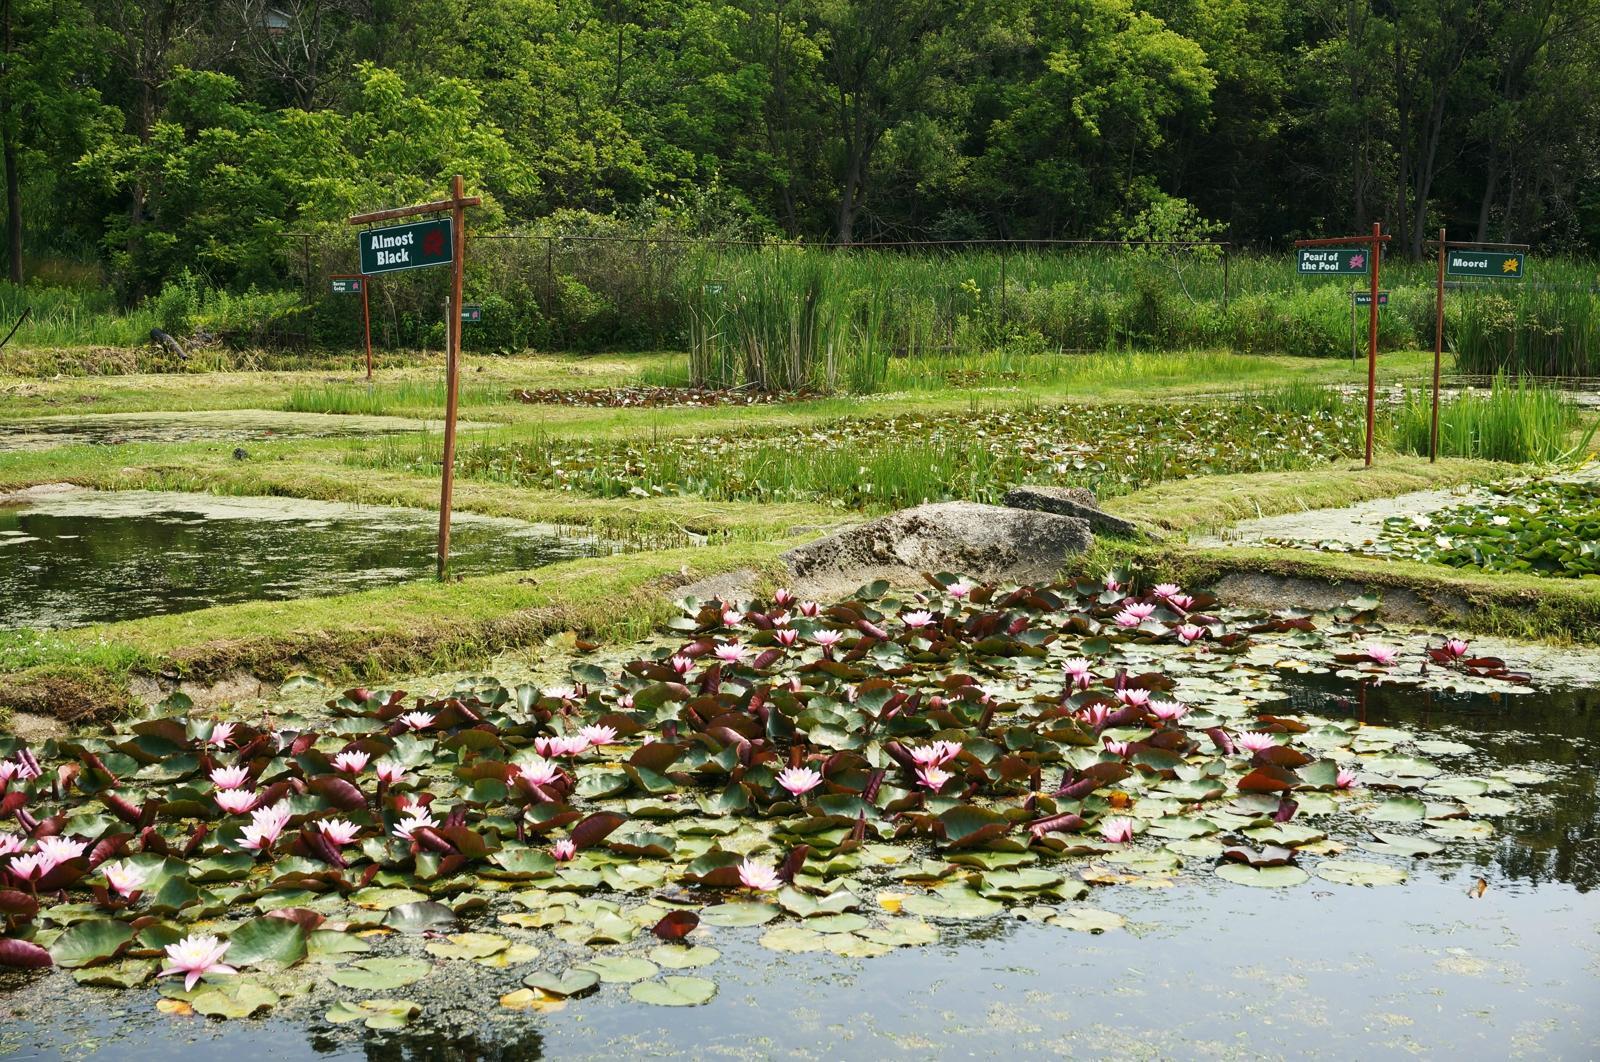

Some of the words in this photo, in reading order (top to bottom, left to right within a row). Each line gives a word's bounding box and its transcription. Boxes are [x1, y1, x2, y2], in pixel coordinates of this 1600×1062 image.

[371, 231, 414, 250] Almost
[376, 248, 409, 266] Black
[1303, 252, 1327, 261] Pearl
[1328, 252, 1339, 261] of
[1301, 261, 1317, 270] the
[1318, 261, 1339, 270] Pool
[1452, 258, 1488, 268] Moorei
